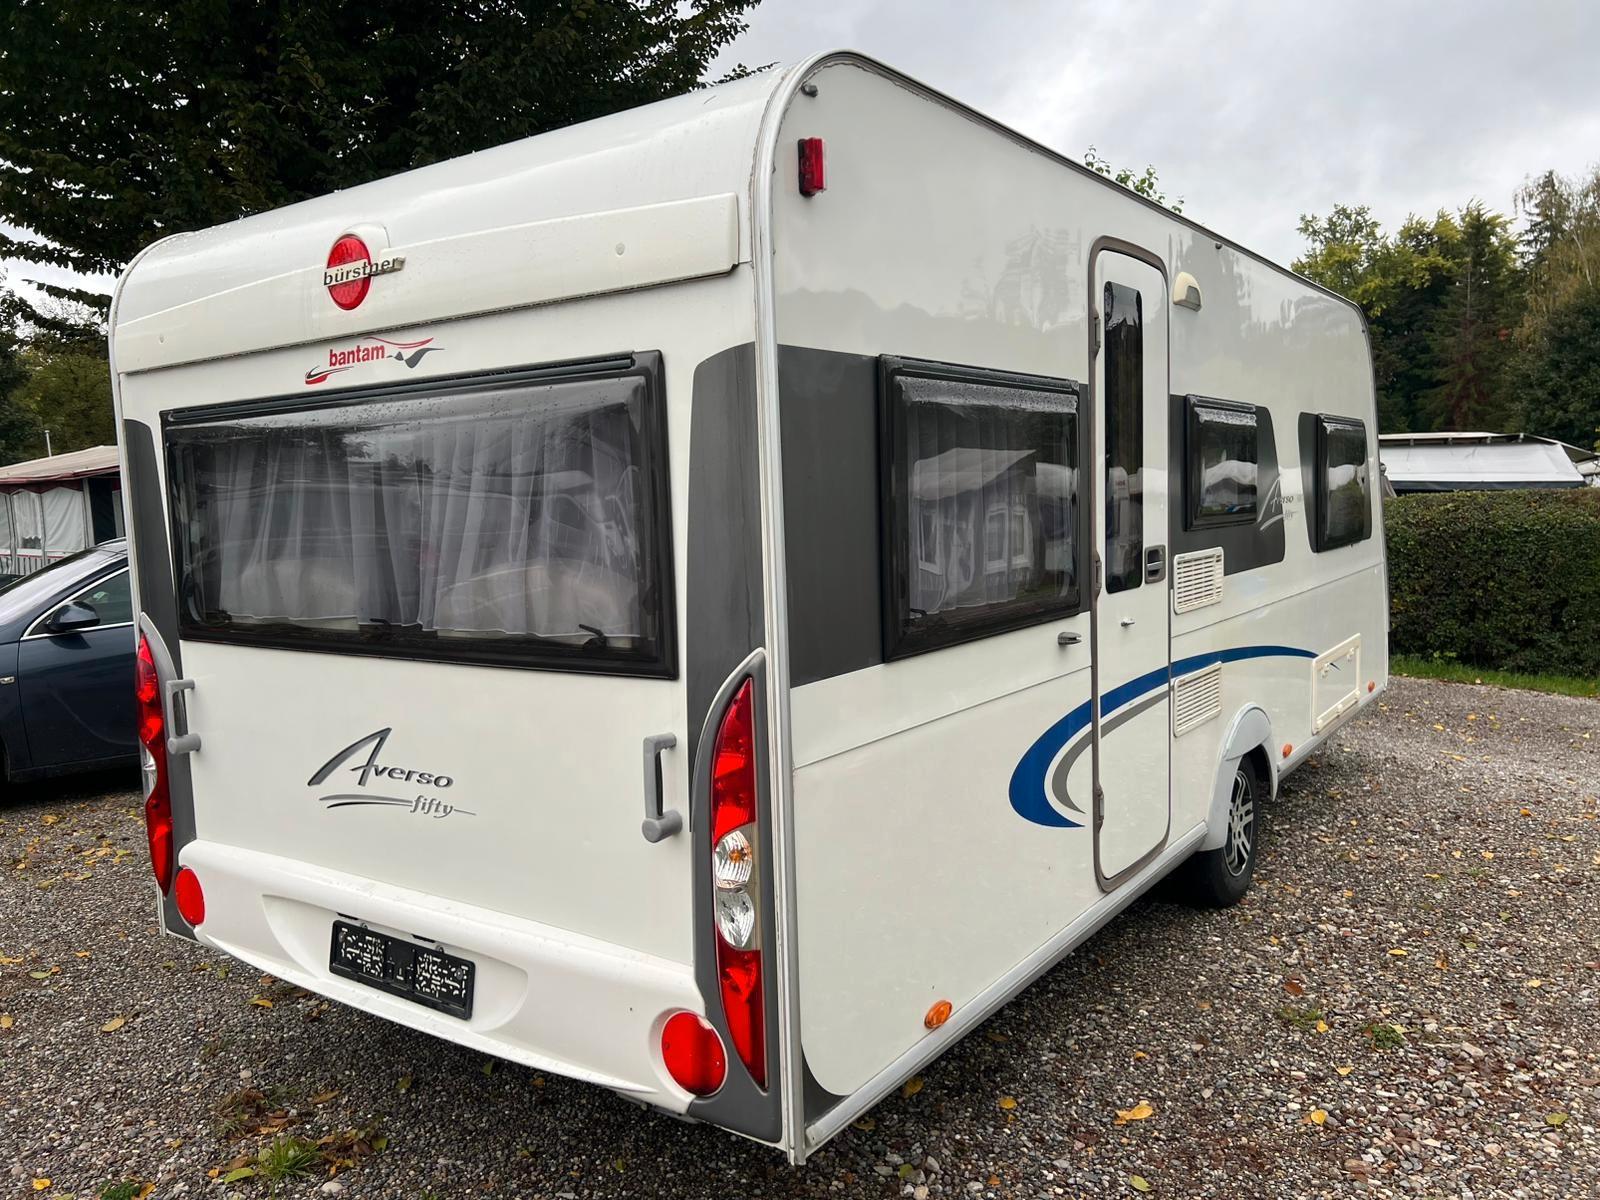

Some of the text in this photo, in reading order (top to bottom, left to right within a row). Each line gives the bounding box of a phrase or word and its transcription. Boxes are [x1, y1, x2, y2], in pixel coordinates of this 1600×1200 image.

[324, 257, 399, 286] bürstner
[329, 345, 385, 367] bantam
[307, 727, 454, 788] Averso
[410, 795, 454, 818] fifty
